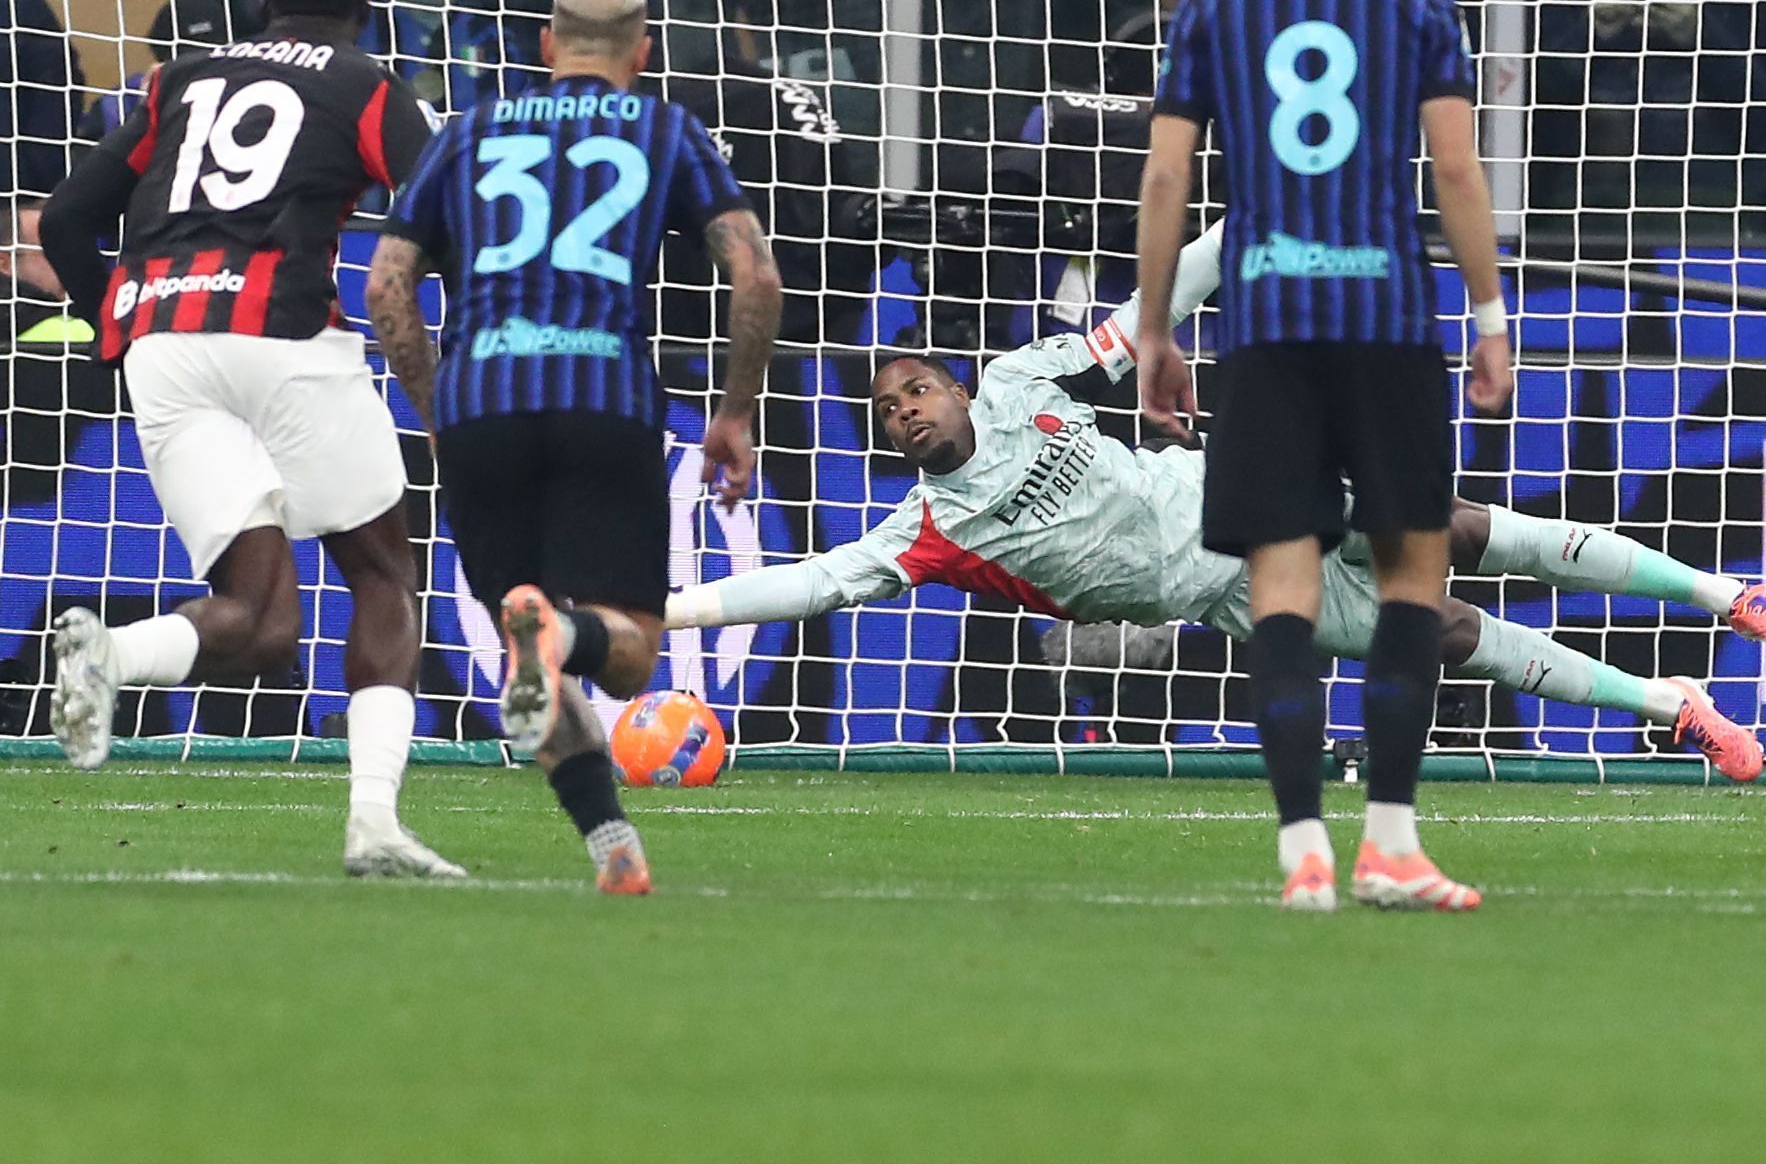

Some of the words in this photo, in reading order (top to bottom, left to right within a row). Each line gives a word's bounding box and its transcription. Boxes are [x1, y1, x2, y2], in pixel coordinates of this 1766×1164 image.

[168, 77, 305, 213] 19
[493, 93, 642, 123] DIMARCO
[1264, 20, 1360, 176] 8
[473, 134, 650, 286] 32
[1030, 491, 1062, 526] FLY
